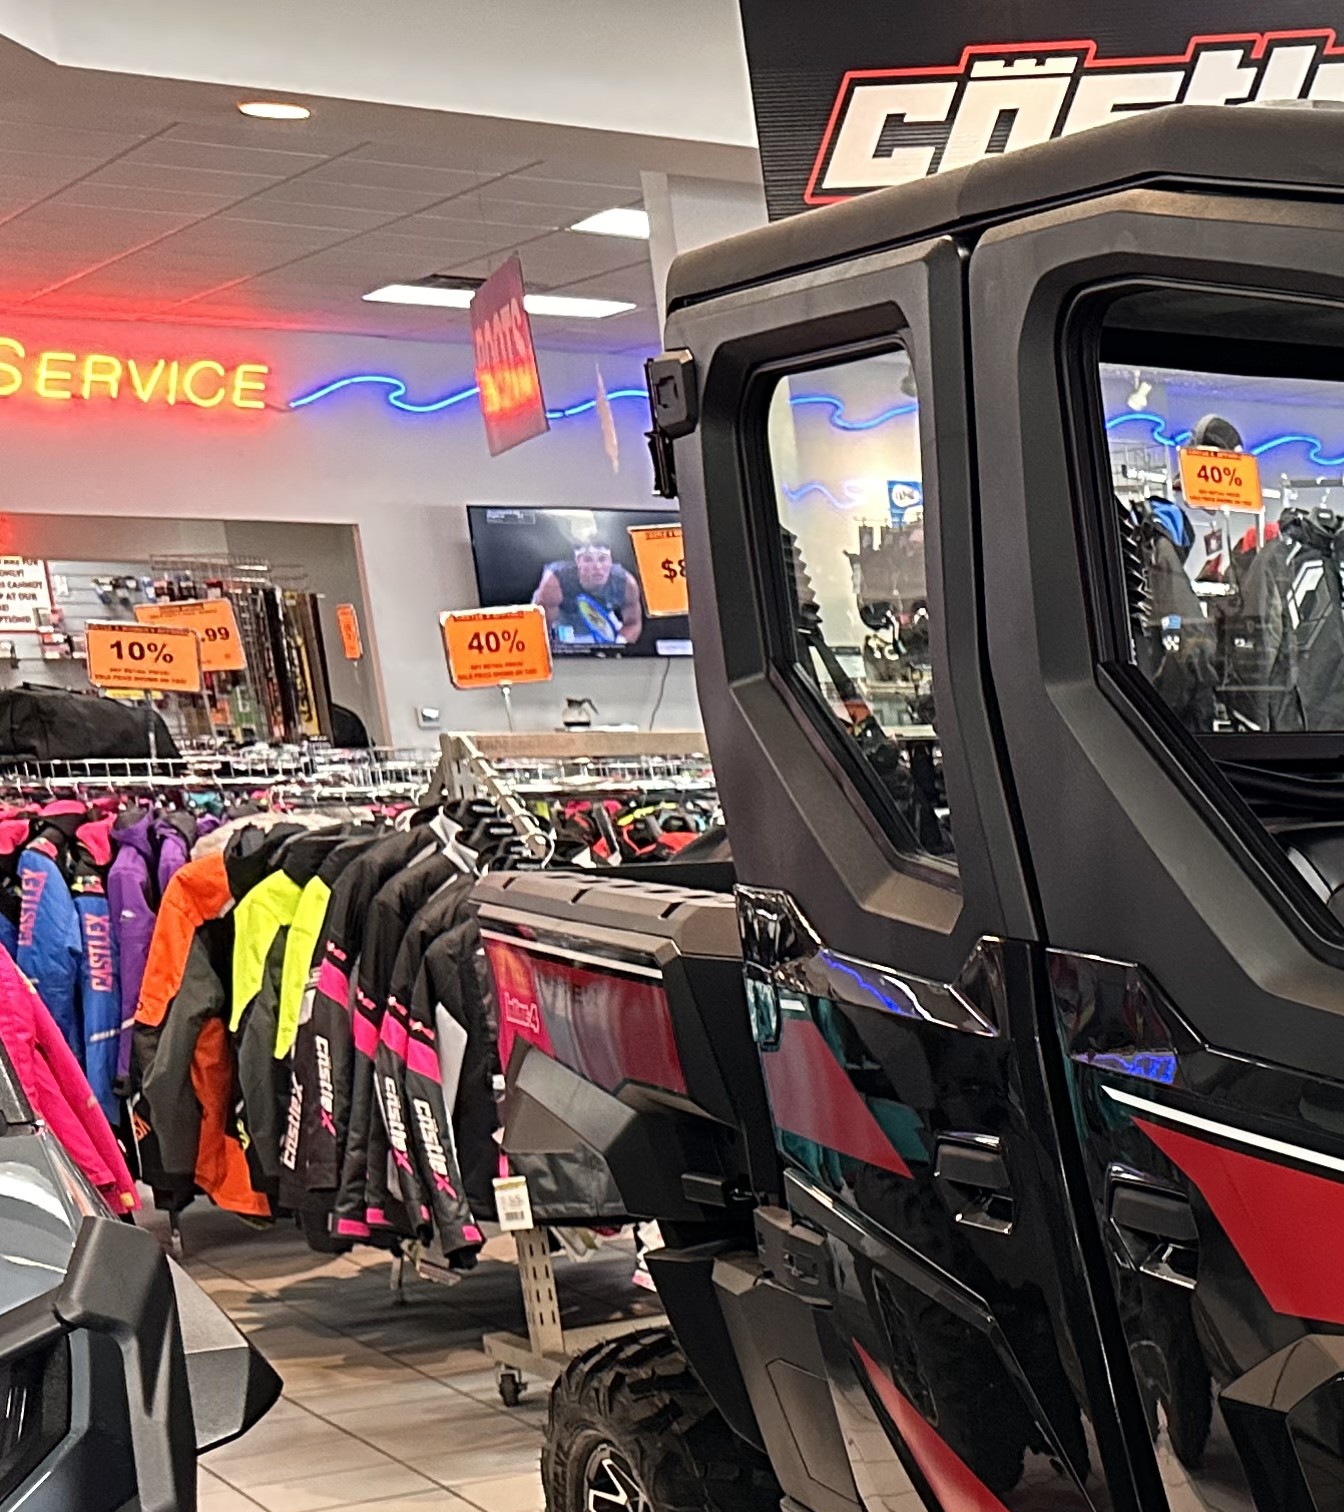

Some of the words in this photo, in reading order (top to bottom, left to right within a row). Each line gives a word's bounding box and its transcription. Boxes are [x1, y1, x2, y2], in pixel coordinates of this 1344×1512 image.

[0, 337, 268, 409] SERVICE
[1197, 465, 1242, 487] 40%
[110, 640, 174, 664] 10%
[468, 629, 526, 654] 40%
[17, 867, 49, 948] CASTLEX
[83, 912, 114, 993] CASTLEX
